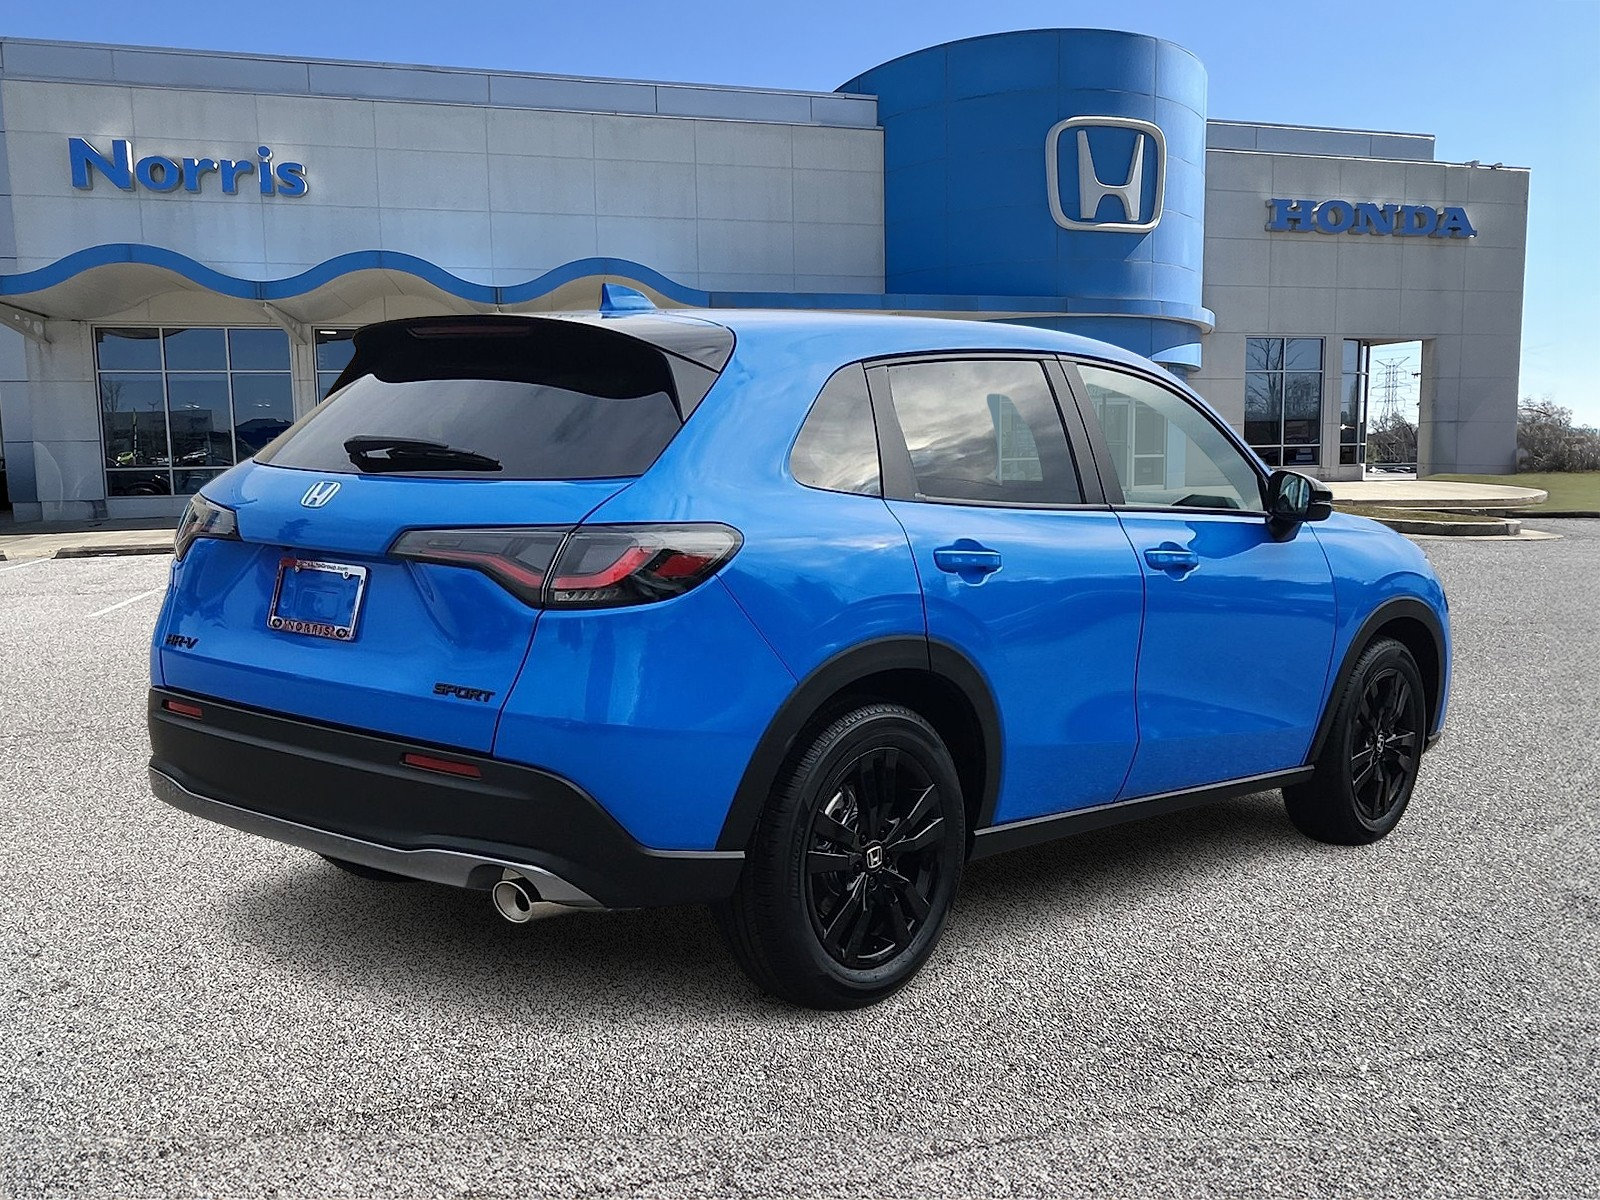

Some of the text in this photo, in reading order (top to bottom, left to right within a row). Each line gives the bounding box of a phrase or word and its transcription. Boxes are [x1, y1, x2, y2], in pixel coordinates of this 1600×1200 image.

[68, 137, 309, 197] Norris
[1265, 198, 1478, 239] HONDA
[288, 621, 331, 636] NORRIS
[165, 633, 200, 649] HR-V
[432, 682, 497, 703] SPORT
